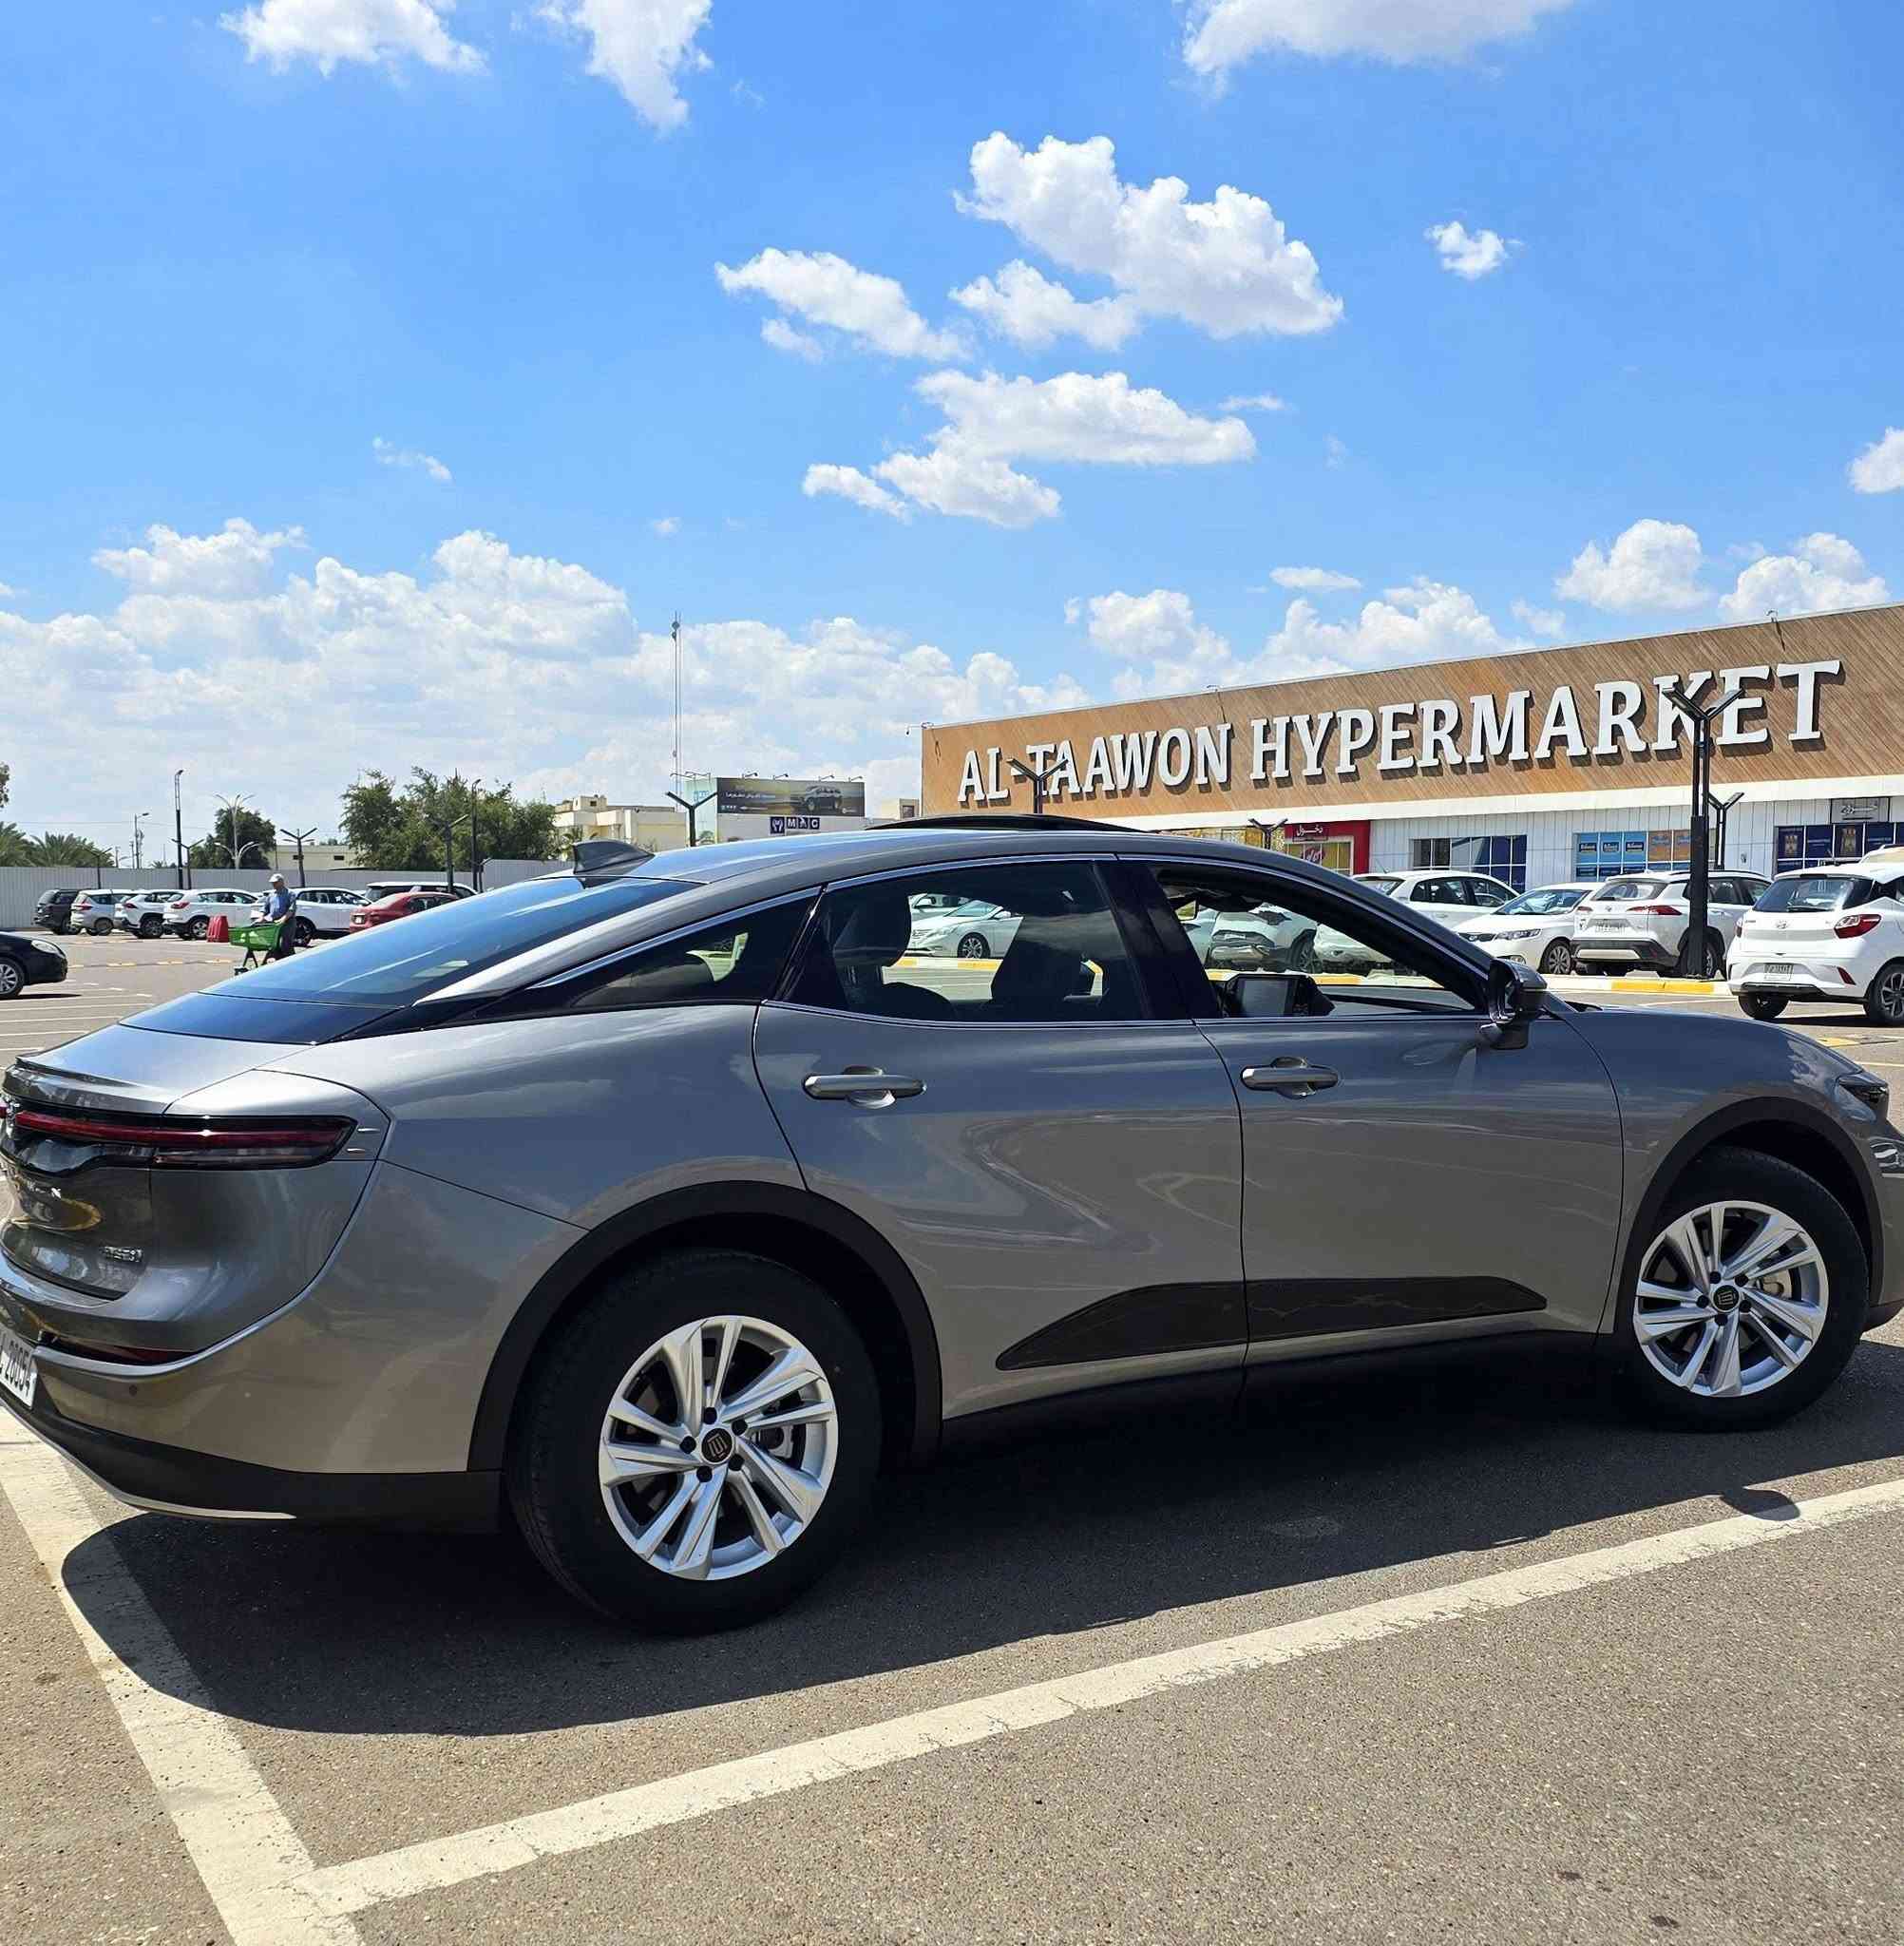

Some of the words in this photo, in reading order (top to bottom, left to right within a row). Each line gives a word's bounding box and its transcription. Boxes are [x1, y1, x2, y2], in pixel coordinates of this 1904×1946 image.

[958, 723, 1232, 801] AL-TAAWON
[1249, 660, 1842, 780] HYPERMARKET
[787, 818, 819, 829] MAC
[1296, 824, 1323, 836] دخول
